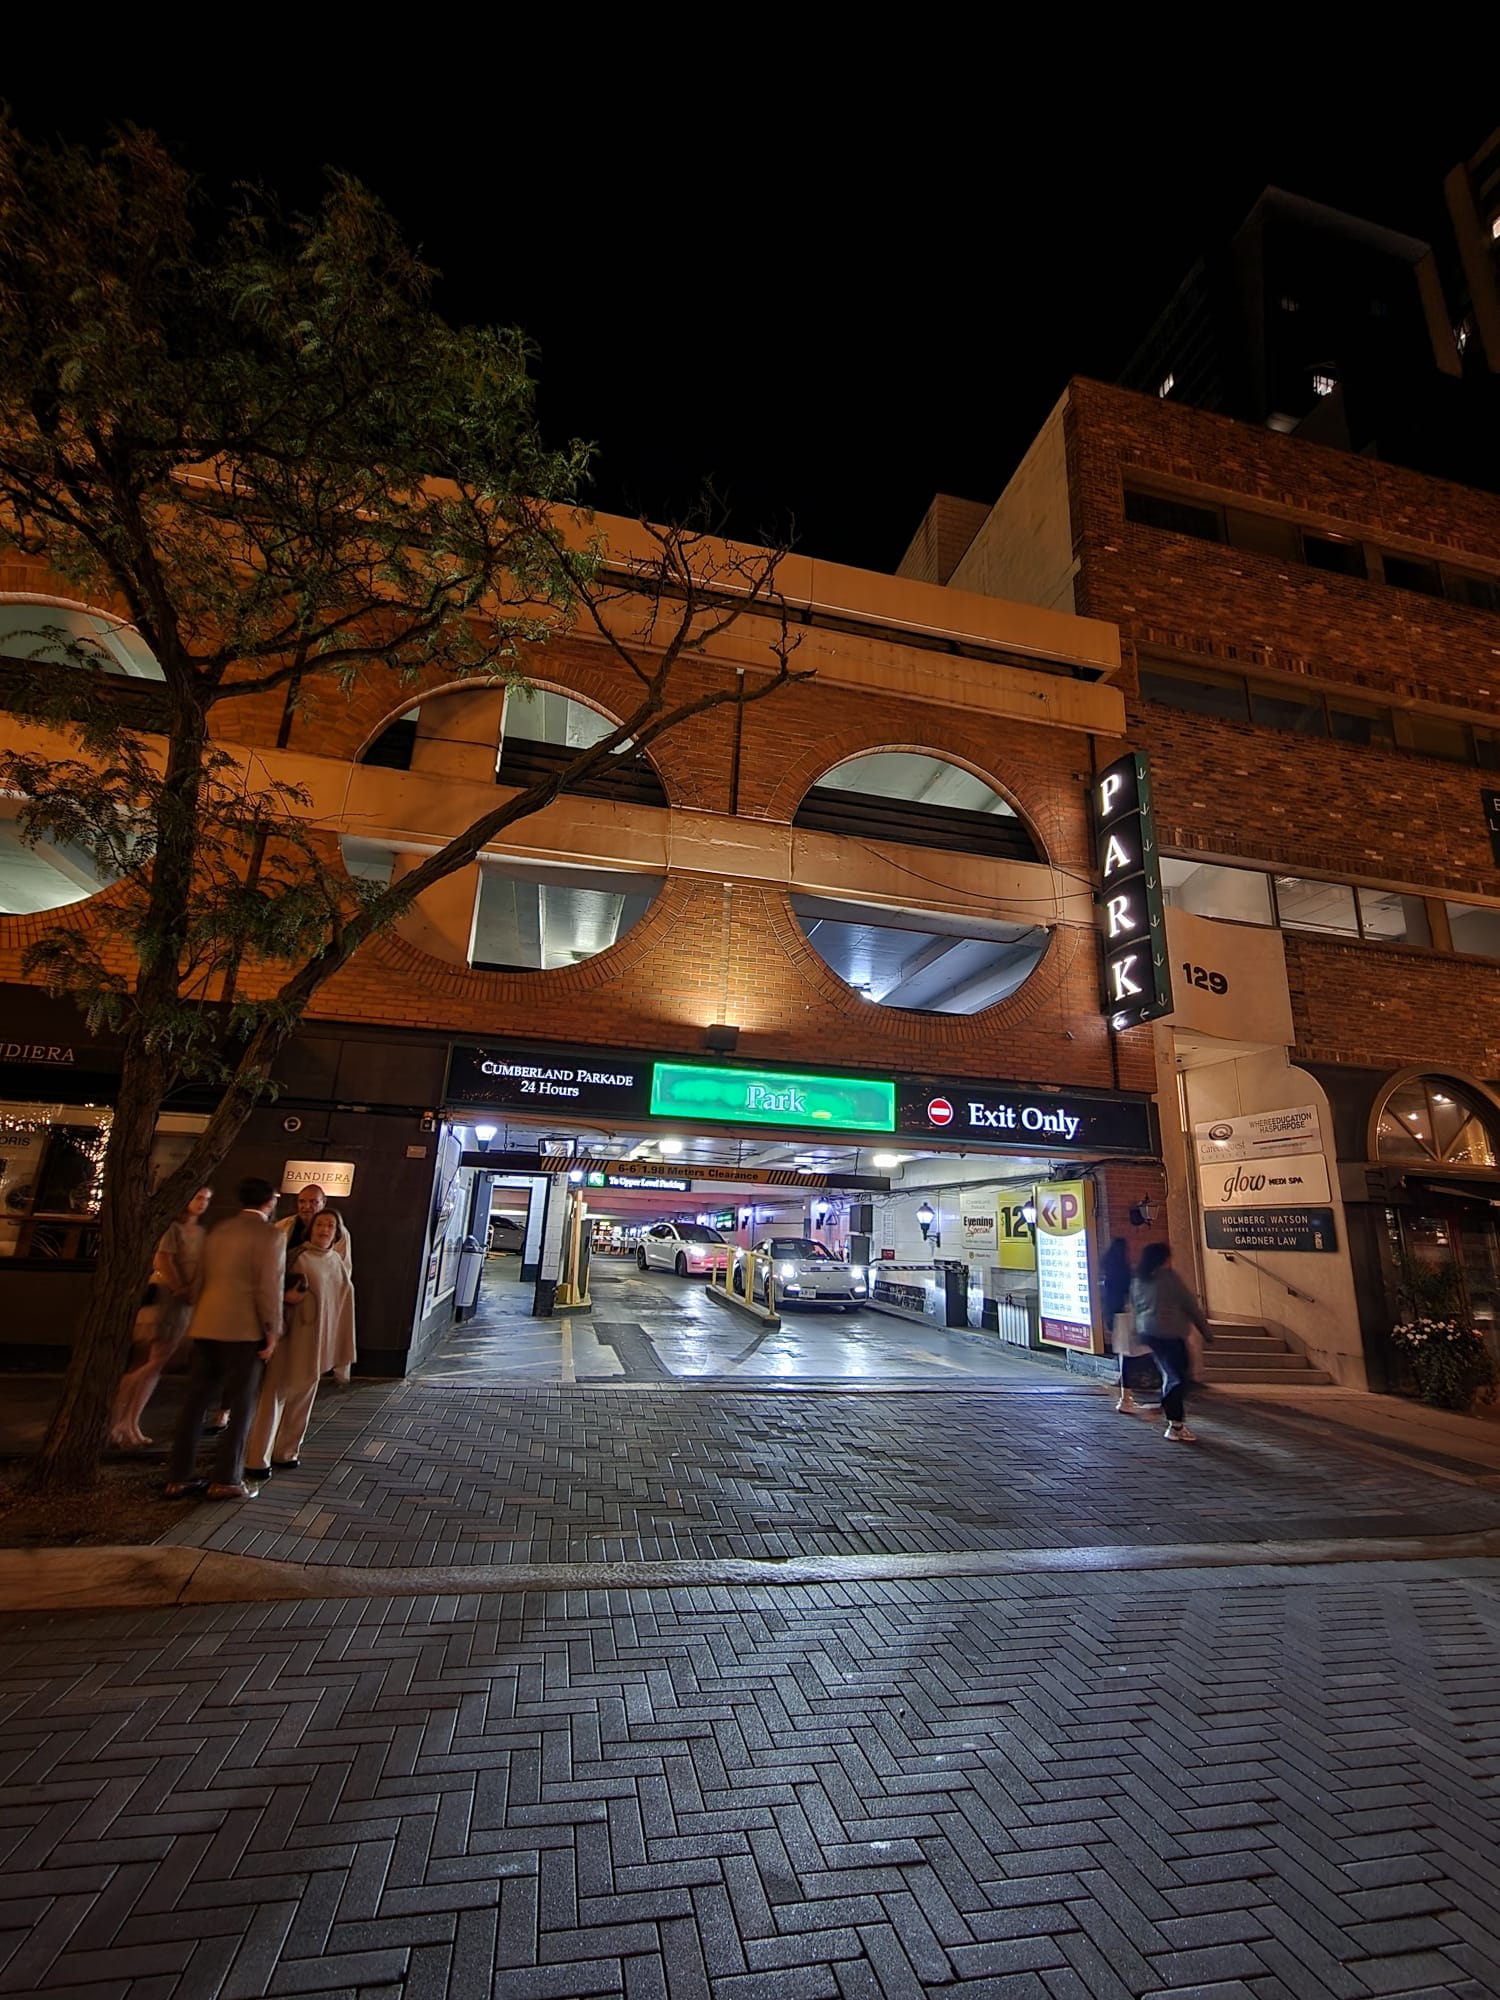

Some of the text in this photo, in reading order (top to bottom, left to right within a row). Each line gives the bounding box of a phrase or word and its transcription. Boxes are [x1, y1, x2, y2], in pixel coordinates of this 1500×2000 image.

[1100, 774, 1142, 1001] PARK
[1182, 962, 1228, 995] 129
[481, 1060, 634, 1087] CUMBERLAND PARKADE
[520, 1079, 580, 1097] 24 Hours
[747, 1085, 806, 1112] Park
[967, 1102, 1080, 1140] Exit Only
[286, 1170, 350, 1183] BANDIERA
[641, 1165, 665, 1175] 1.98
[667, 1166, 704, 1177] Meters
[708, 1168, 759, 1181] Clearance
[1220, 1166, 1304, 1202] glow MEDI SPA
[963, 1216, 994, 1228] Evening
[1222, 1215, 1308, 1225] HOLMBERG WATSON
[1235, 1236, 1297, 1246] GARDNER LAW
